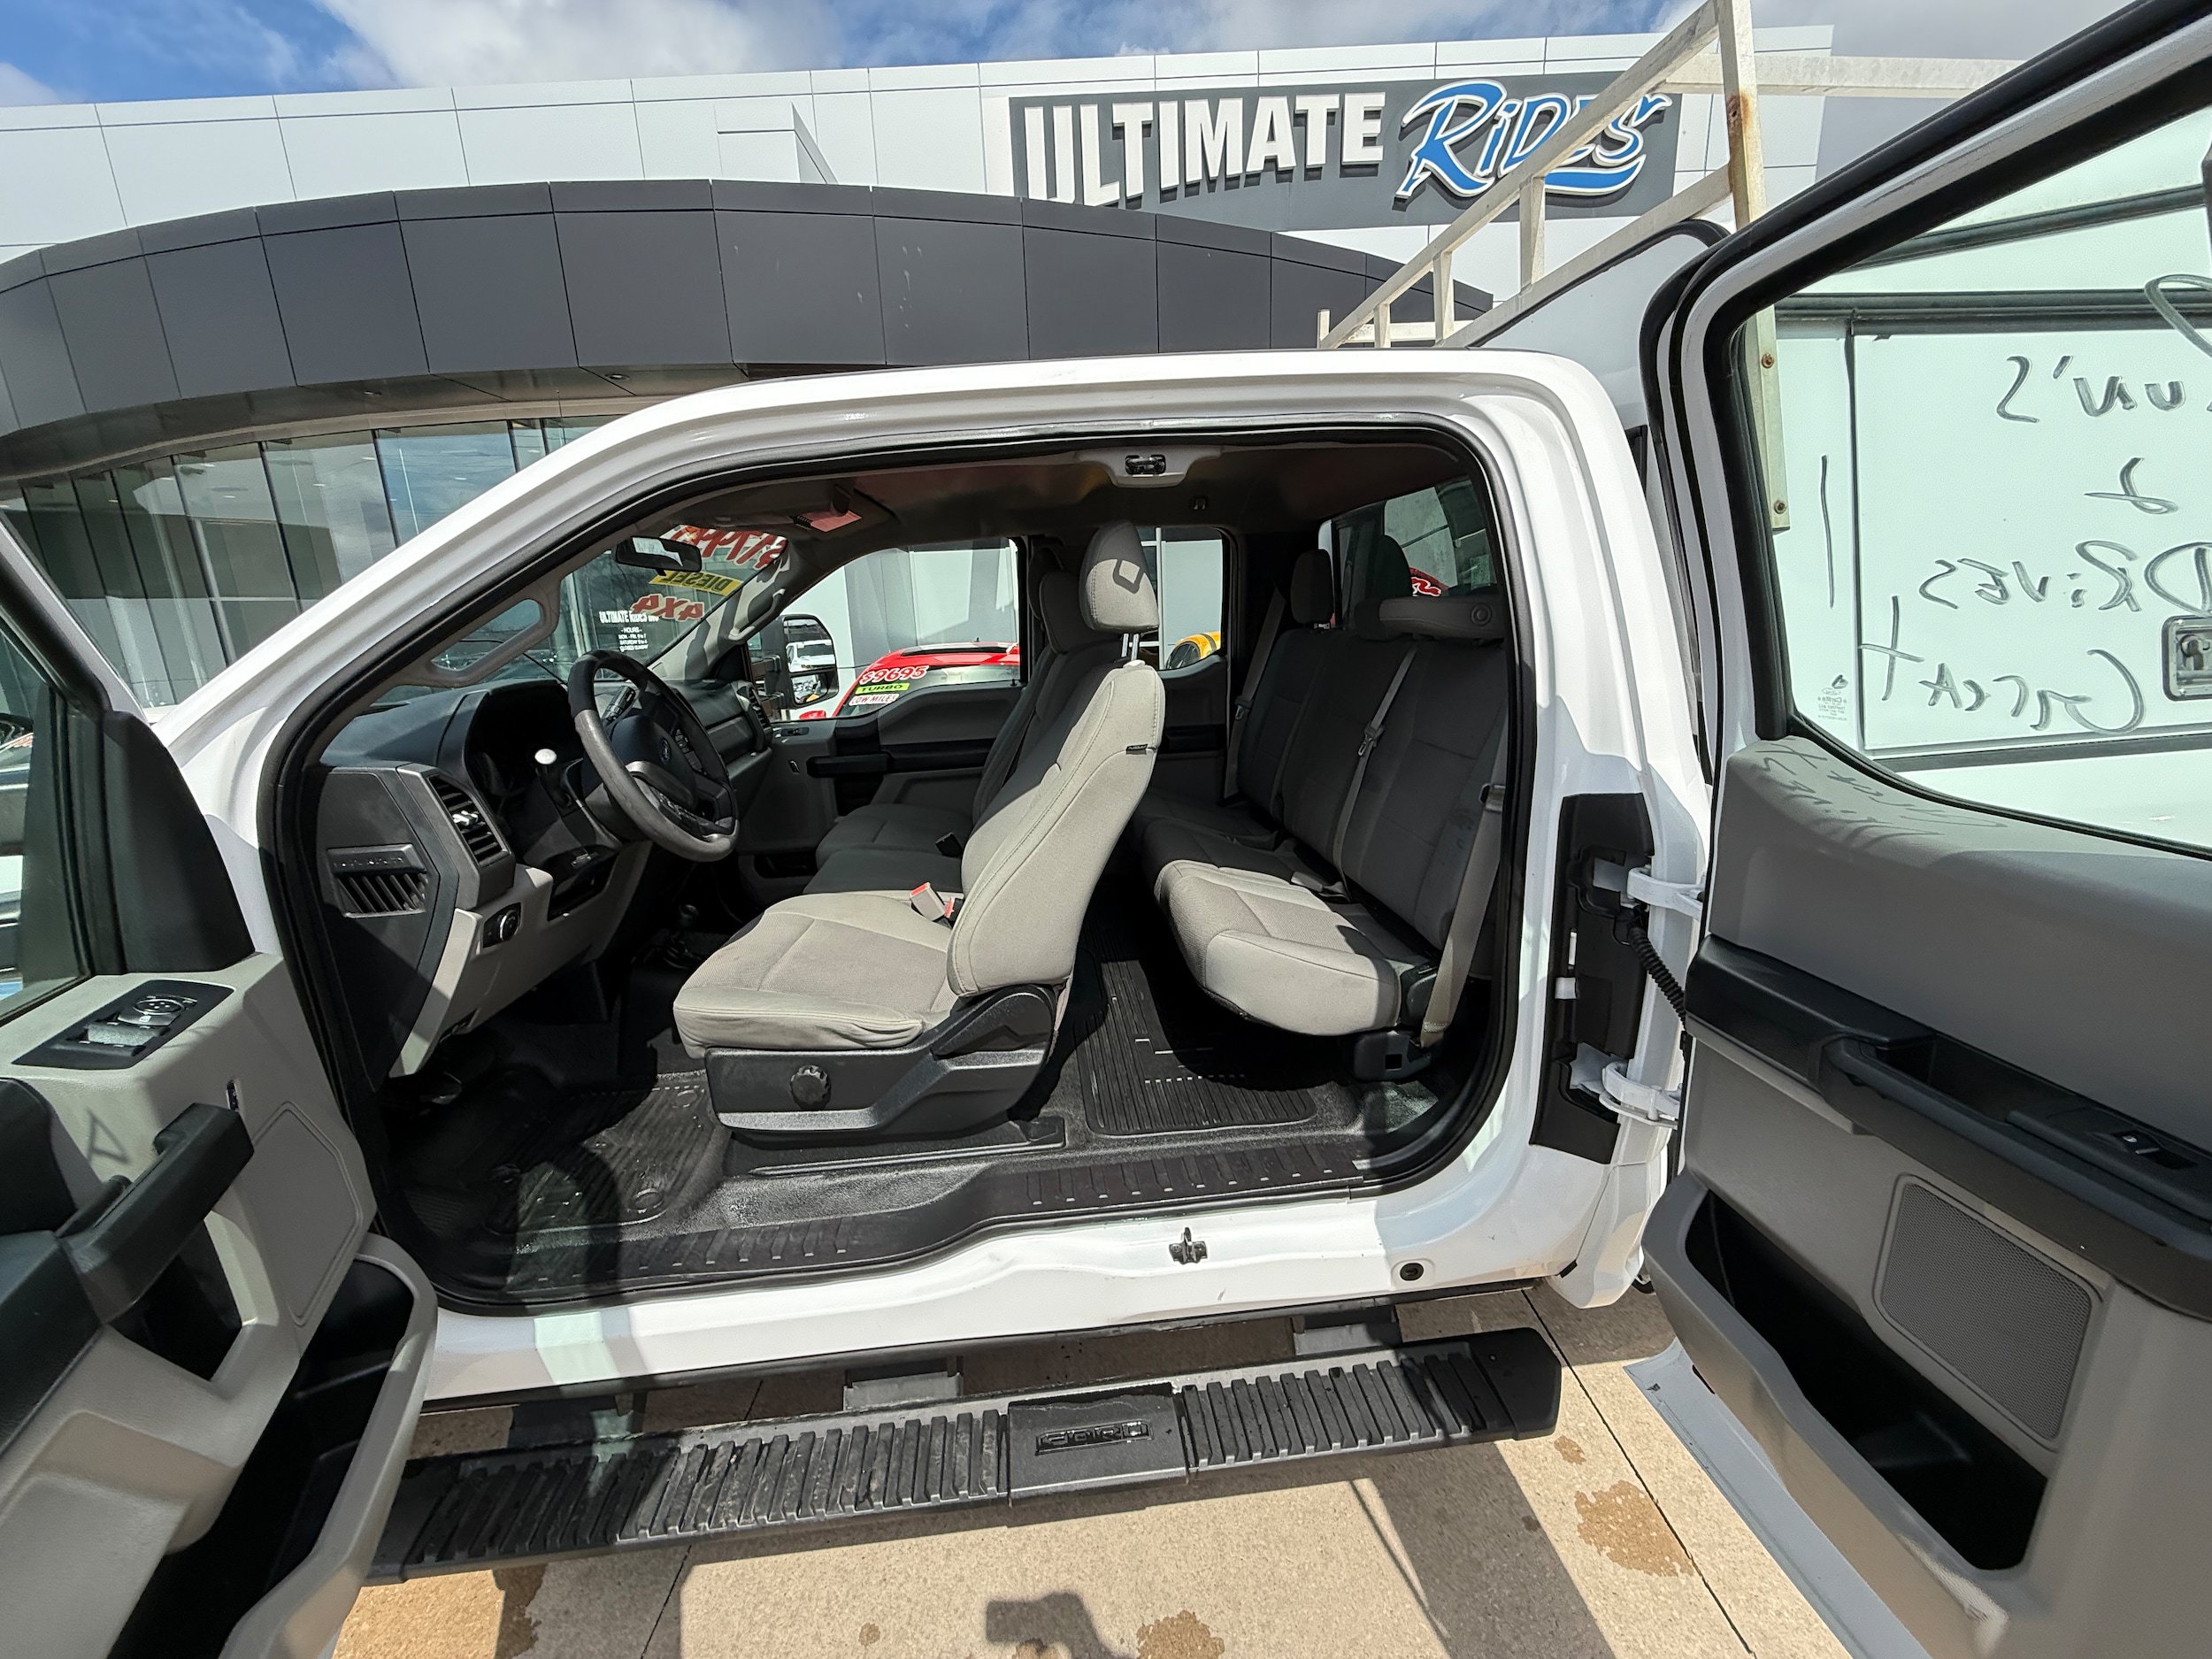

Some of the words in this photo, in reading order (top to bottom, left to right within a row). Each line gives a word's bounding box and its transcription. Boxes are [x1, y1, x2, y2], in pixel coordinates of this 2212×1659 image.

[1024, 92, 1384, 206] ULTIMATE
[599, 611, 629, 623] ULTIMATE
[858, 665, 928, 685] $9695
